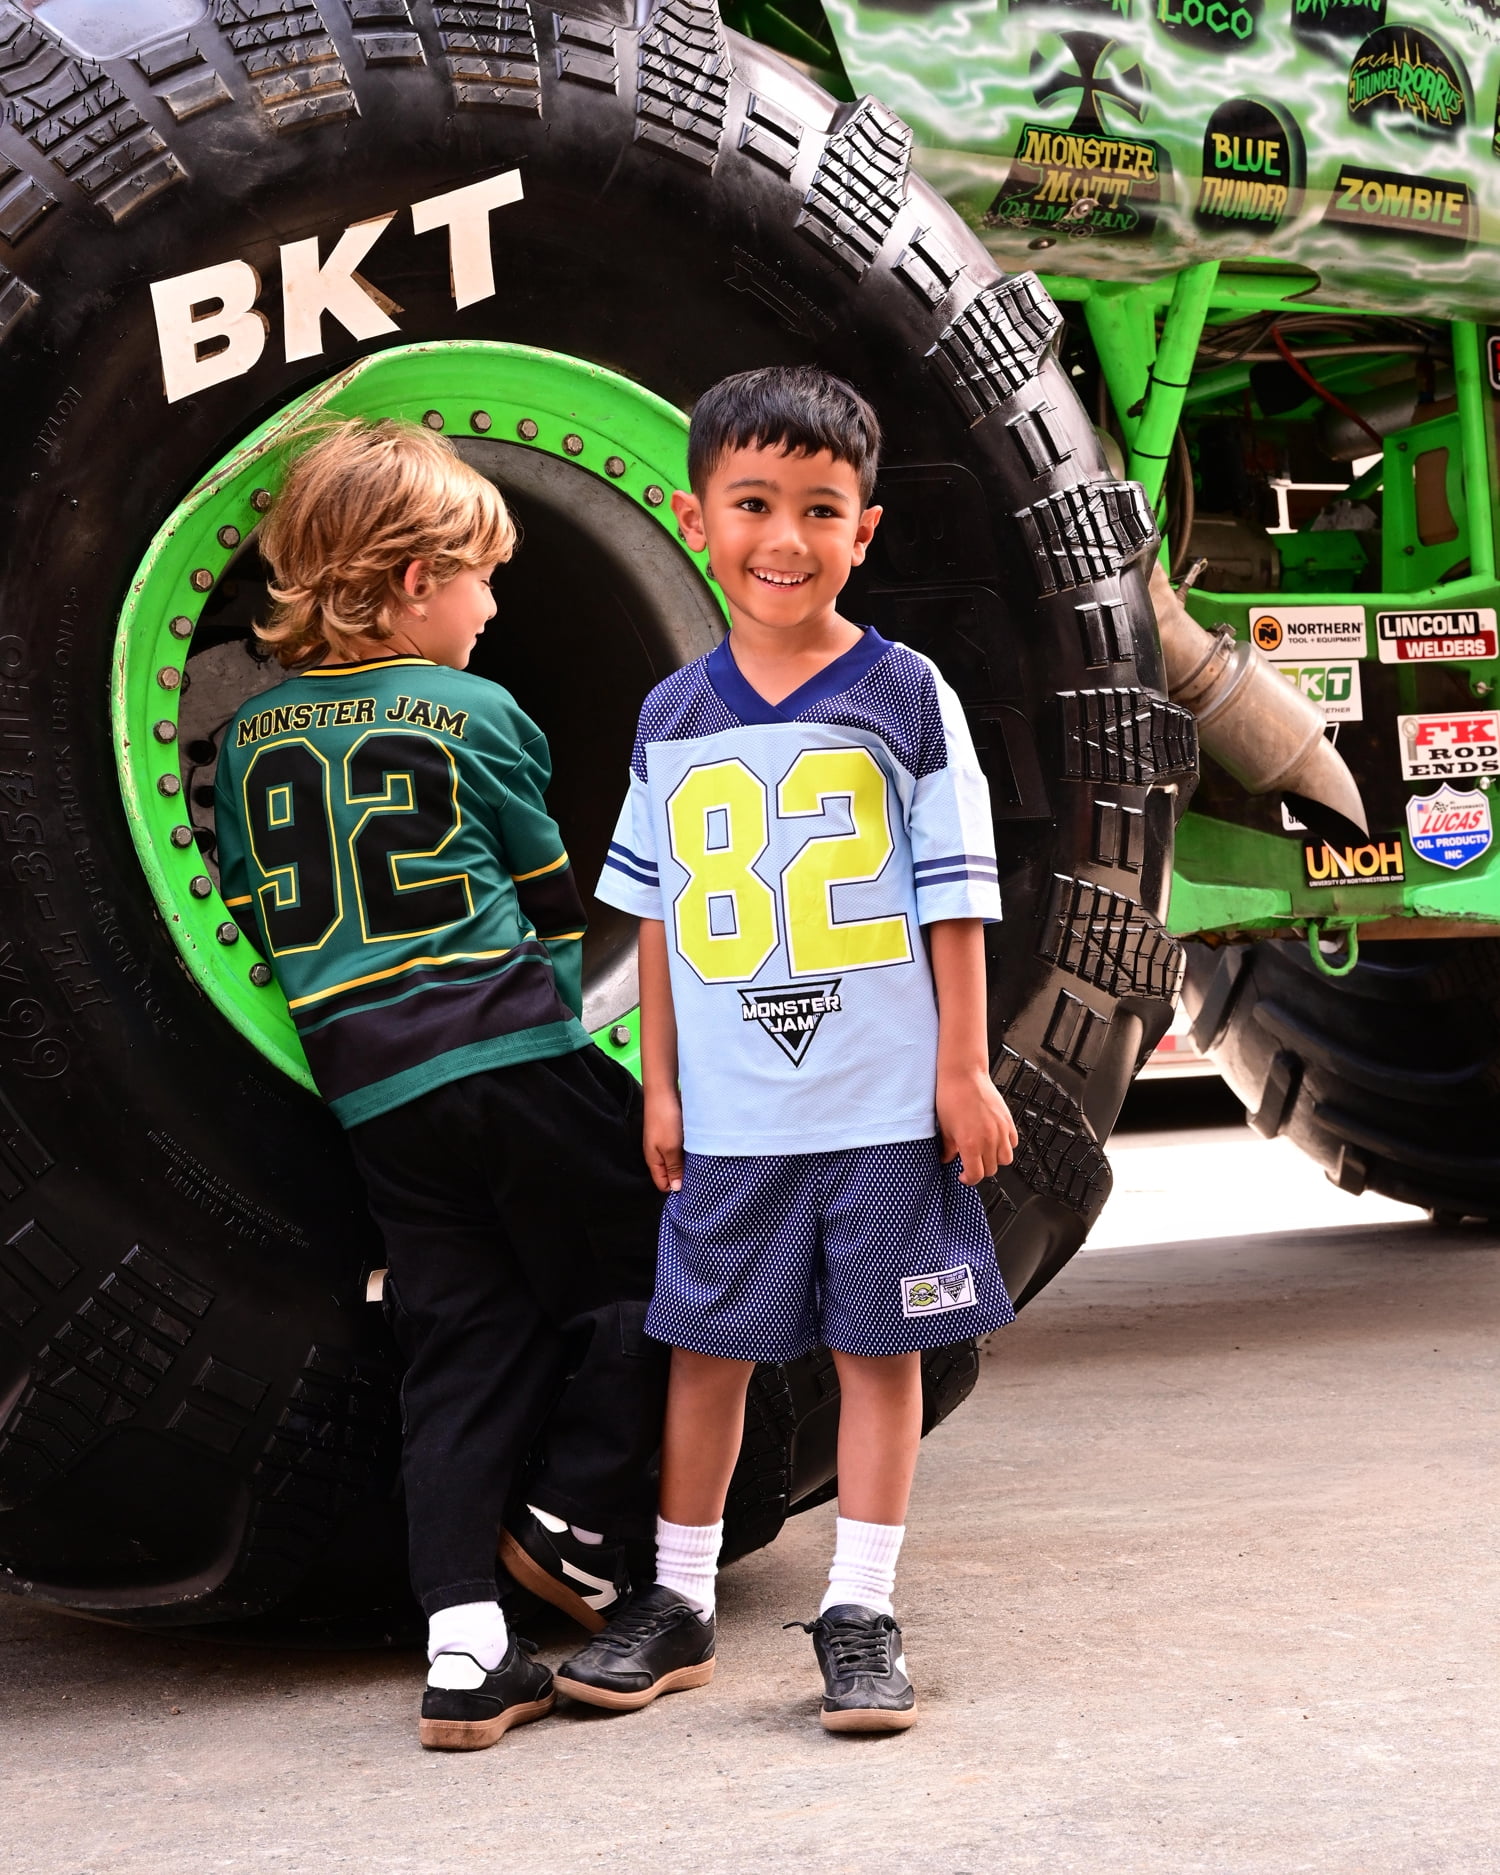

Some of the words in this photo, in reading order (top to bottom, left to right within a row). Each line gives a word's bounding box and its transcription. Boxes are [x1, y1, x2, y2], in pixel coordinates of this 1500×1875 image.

[1157, 0, 1253, 39] LOCO
[1022, 131, 1155, 180] MONSTER
[1211, 133, 1281, 176] BLUE
[1034, 170, 1129, 209] MUTT
[1200, 176, 1288, 224] THUNDER
[1335, 176, 1464, 225] ZOMBIE
[1003, 201, 1133, 229] DALMIAN
[150, 168, 524, 403] BKT
[1287, 623, 1361, 635] NORTHERN
[1384, 614, 1475, 637] LINCOLN
[1405, 639, 1487, 658] WELDERS
[236, 698, 376, 748] MONSTER
[387, 695, 468, 740] JAM
[1323, 706, 1351, 714] ETHER
[1415, 719, 1496, 745] FK
[1428, 746, 1498, 760] ROD
[1409, 760, 1499, 776] ENDS
[1420, 810, 1483, 834] LUCAS
[243, 728, 475, 957] 92
[1416, 840, 1434, 849] OIL
[1436, 834, 1488, 847] PRODUCTS
[656, 746, 915, 984] 82
[1306, 840, 1404, 879] UNOH
[743, 995, 840, 1019] MONSTER
[770, 1015, 814, 1033] JAM
